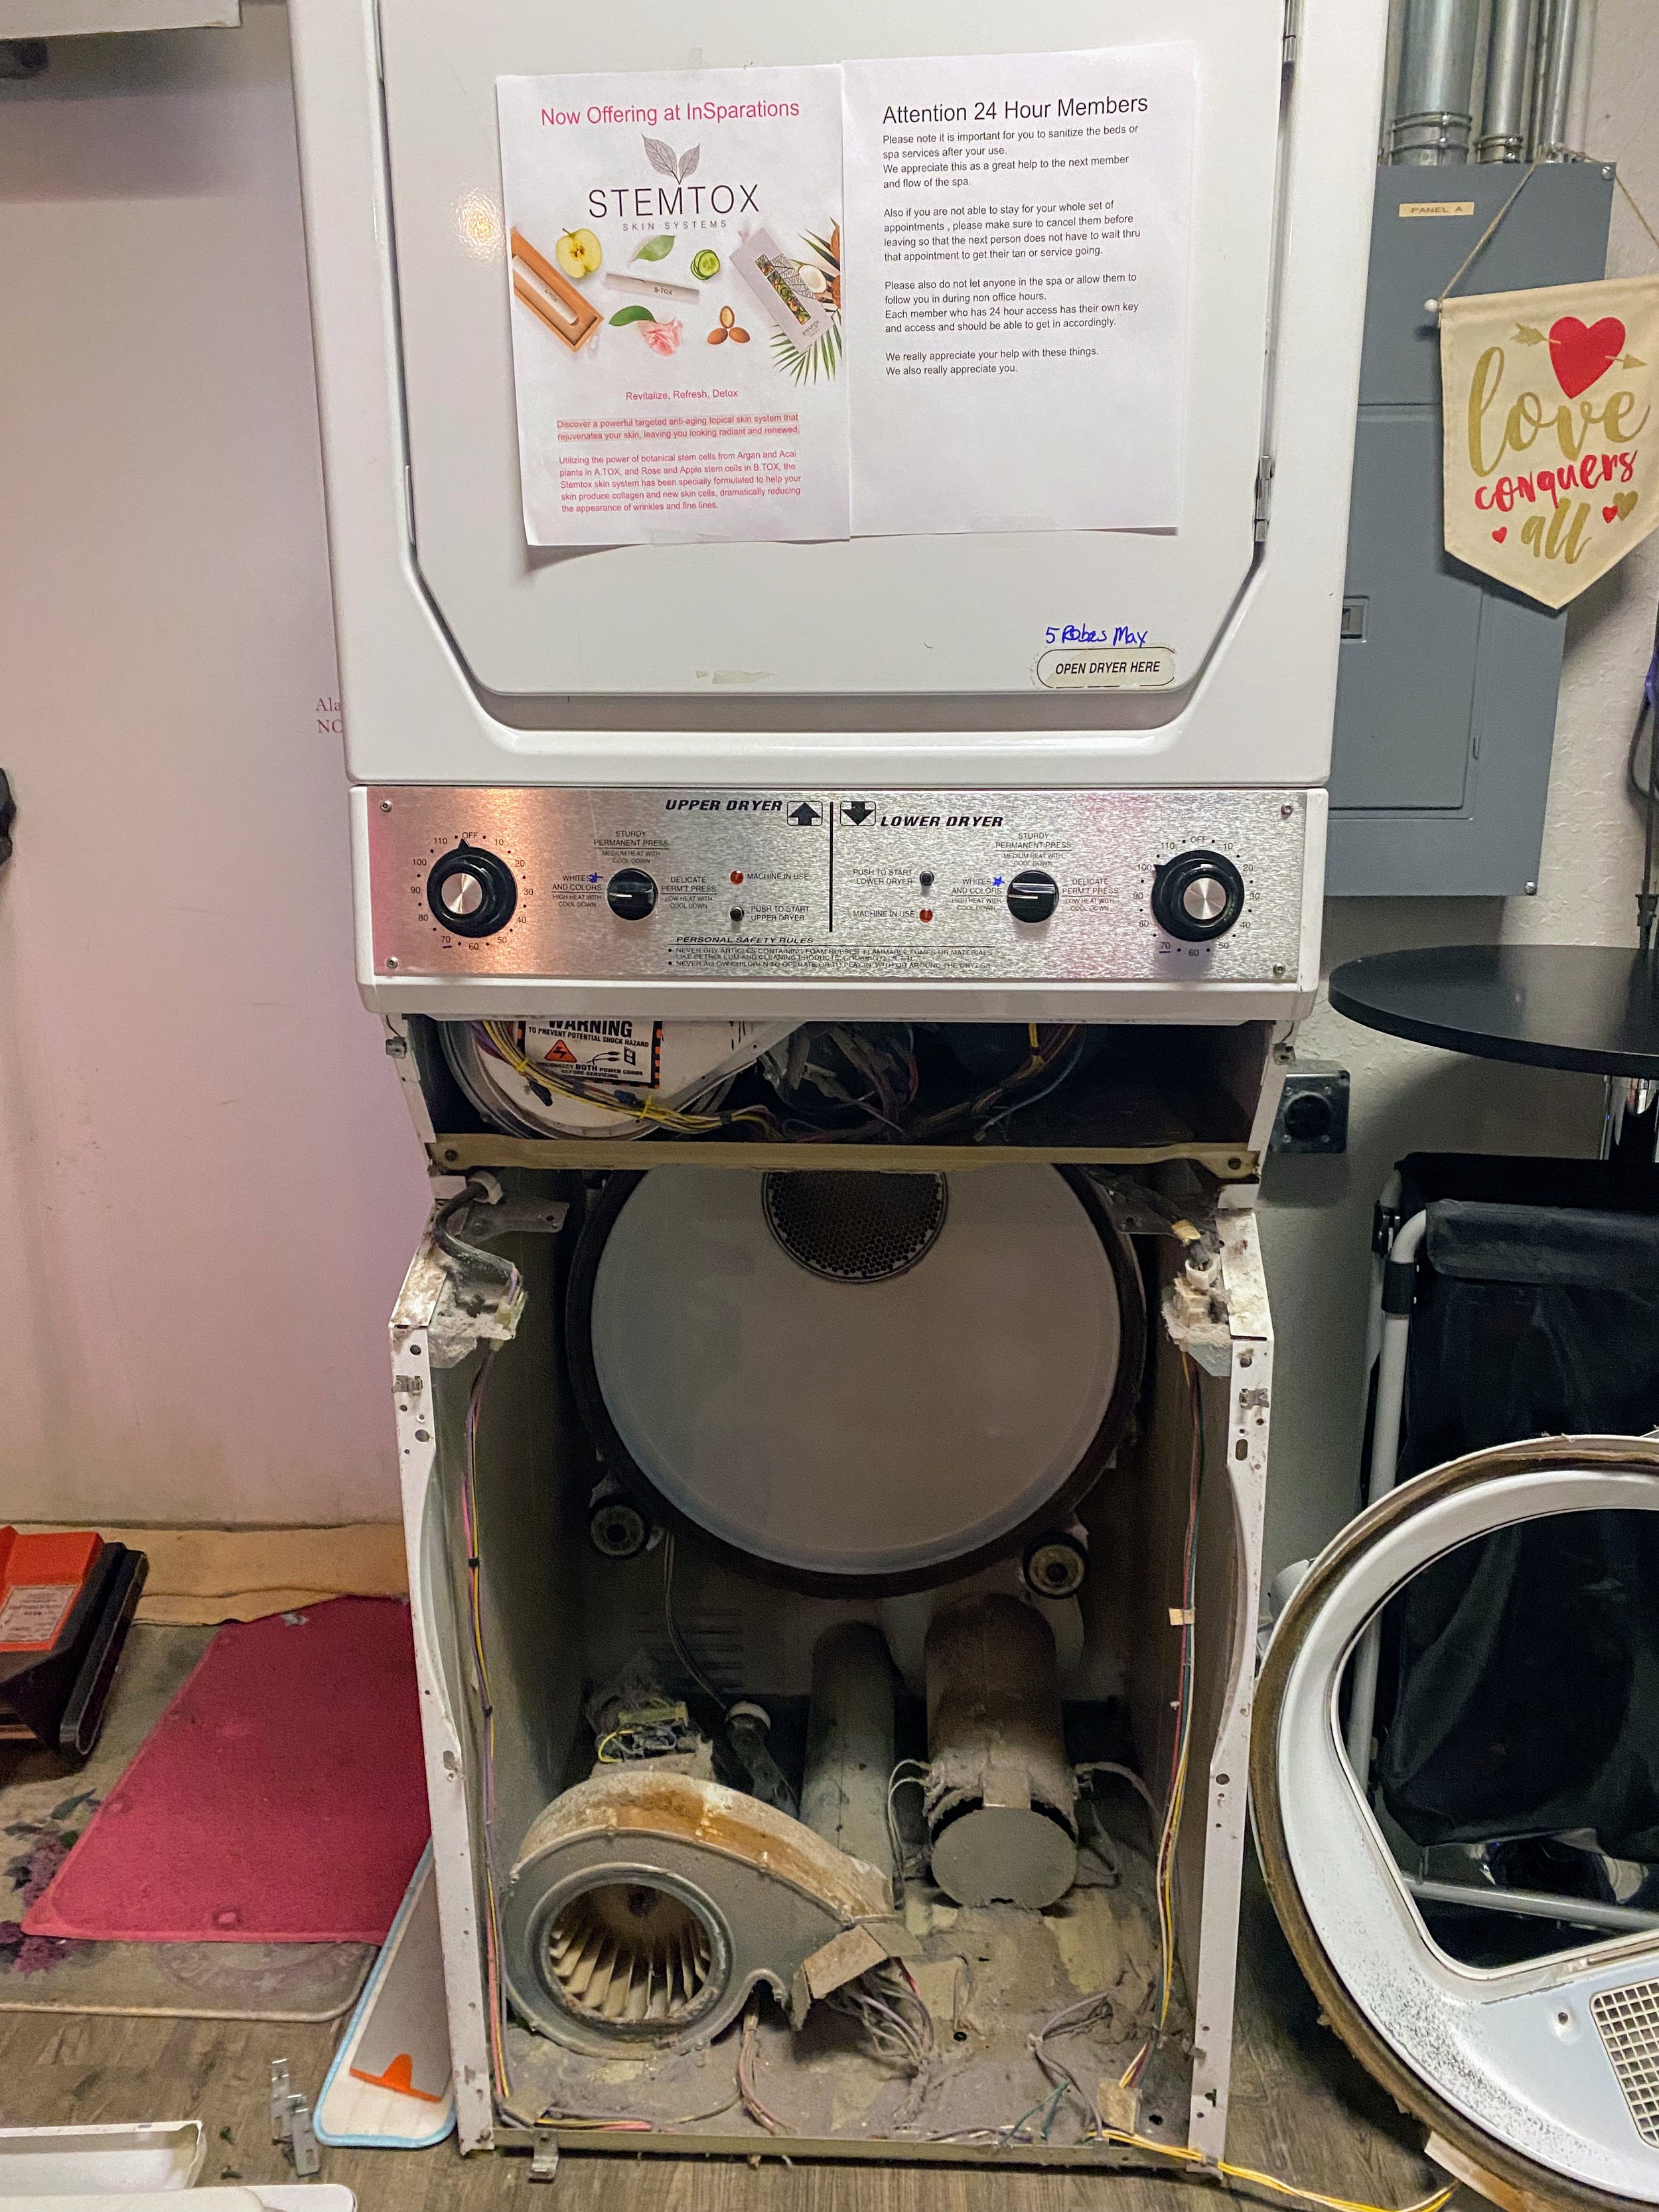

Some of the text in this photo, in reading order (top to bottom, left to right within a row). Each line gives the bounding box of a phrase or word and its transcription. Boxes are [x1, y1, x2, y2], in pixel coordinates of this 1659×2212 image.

[541, 100, 800, 126] Now Offering at InSparations
[882, 96, 1148, 123] Attention 24 Hour Members
[883, 135, 914, 144] Please
[916, 133, 937, 143] note
[938, 133, 945, 141] it
[957, 131, 1001, 143] important
[1002, 130, 1016, 139] for
[1017, 131, 1035, 141] you
[1037, 129, 1046, 138] to
[1048, 128, 1084, 137] sanitize
[1086, 126, 1101, 135] the
[1103, 125, 1127, 135] beds
[882, 147, 1007, 161] spa services after your use.
[883, 164, 899, 173] We
[901, 163, 949, 175] appreciate
[950, 161, 968, 171] this
[991, 160, 1016, 172] great
[1017, 159, 1038, 170] help
[1039, 159, 1049, 168] to
[1050, 158, 1066, 167] the
[1068, 157, 1088, 167] next
[1090, 155, 1129, 165] member
[589, 184, 760, 218] STEMTOX
[622, 220, 727, 231] SKIN SYSTEMS
[711, 389, 738, 398] Detox
[1468, 346, 1651, 478] love
[599, 419, 633, 428] powerful
[634, 417, 667, 427] targeted
[668, 417, 707, 426] anti-aging
[708, 415, 735, 425] topical
[753, 415, 782, 424] system
[557, 432, 603, 441] rejuvenates
[643, 430, 672, 439] leaving
[689, 429, 717, 437] looking
[1475, 449, 1638, 512] conquers
[1521, 498, 1593, 563] all
[1046, 627, 1060, 643] 5
[1062, 623, 1107, 642] Robes
[1056, 662, 1161, 674] OPEN DRYER HERE
[666, 800, 782, 810] UPPER DRYER
[881, 816, 1003, 826] LOWER DRYER
[538, 1029, 566, 1037] PREVENT
[568, 1033, 601, 1042] POTENTIAL
